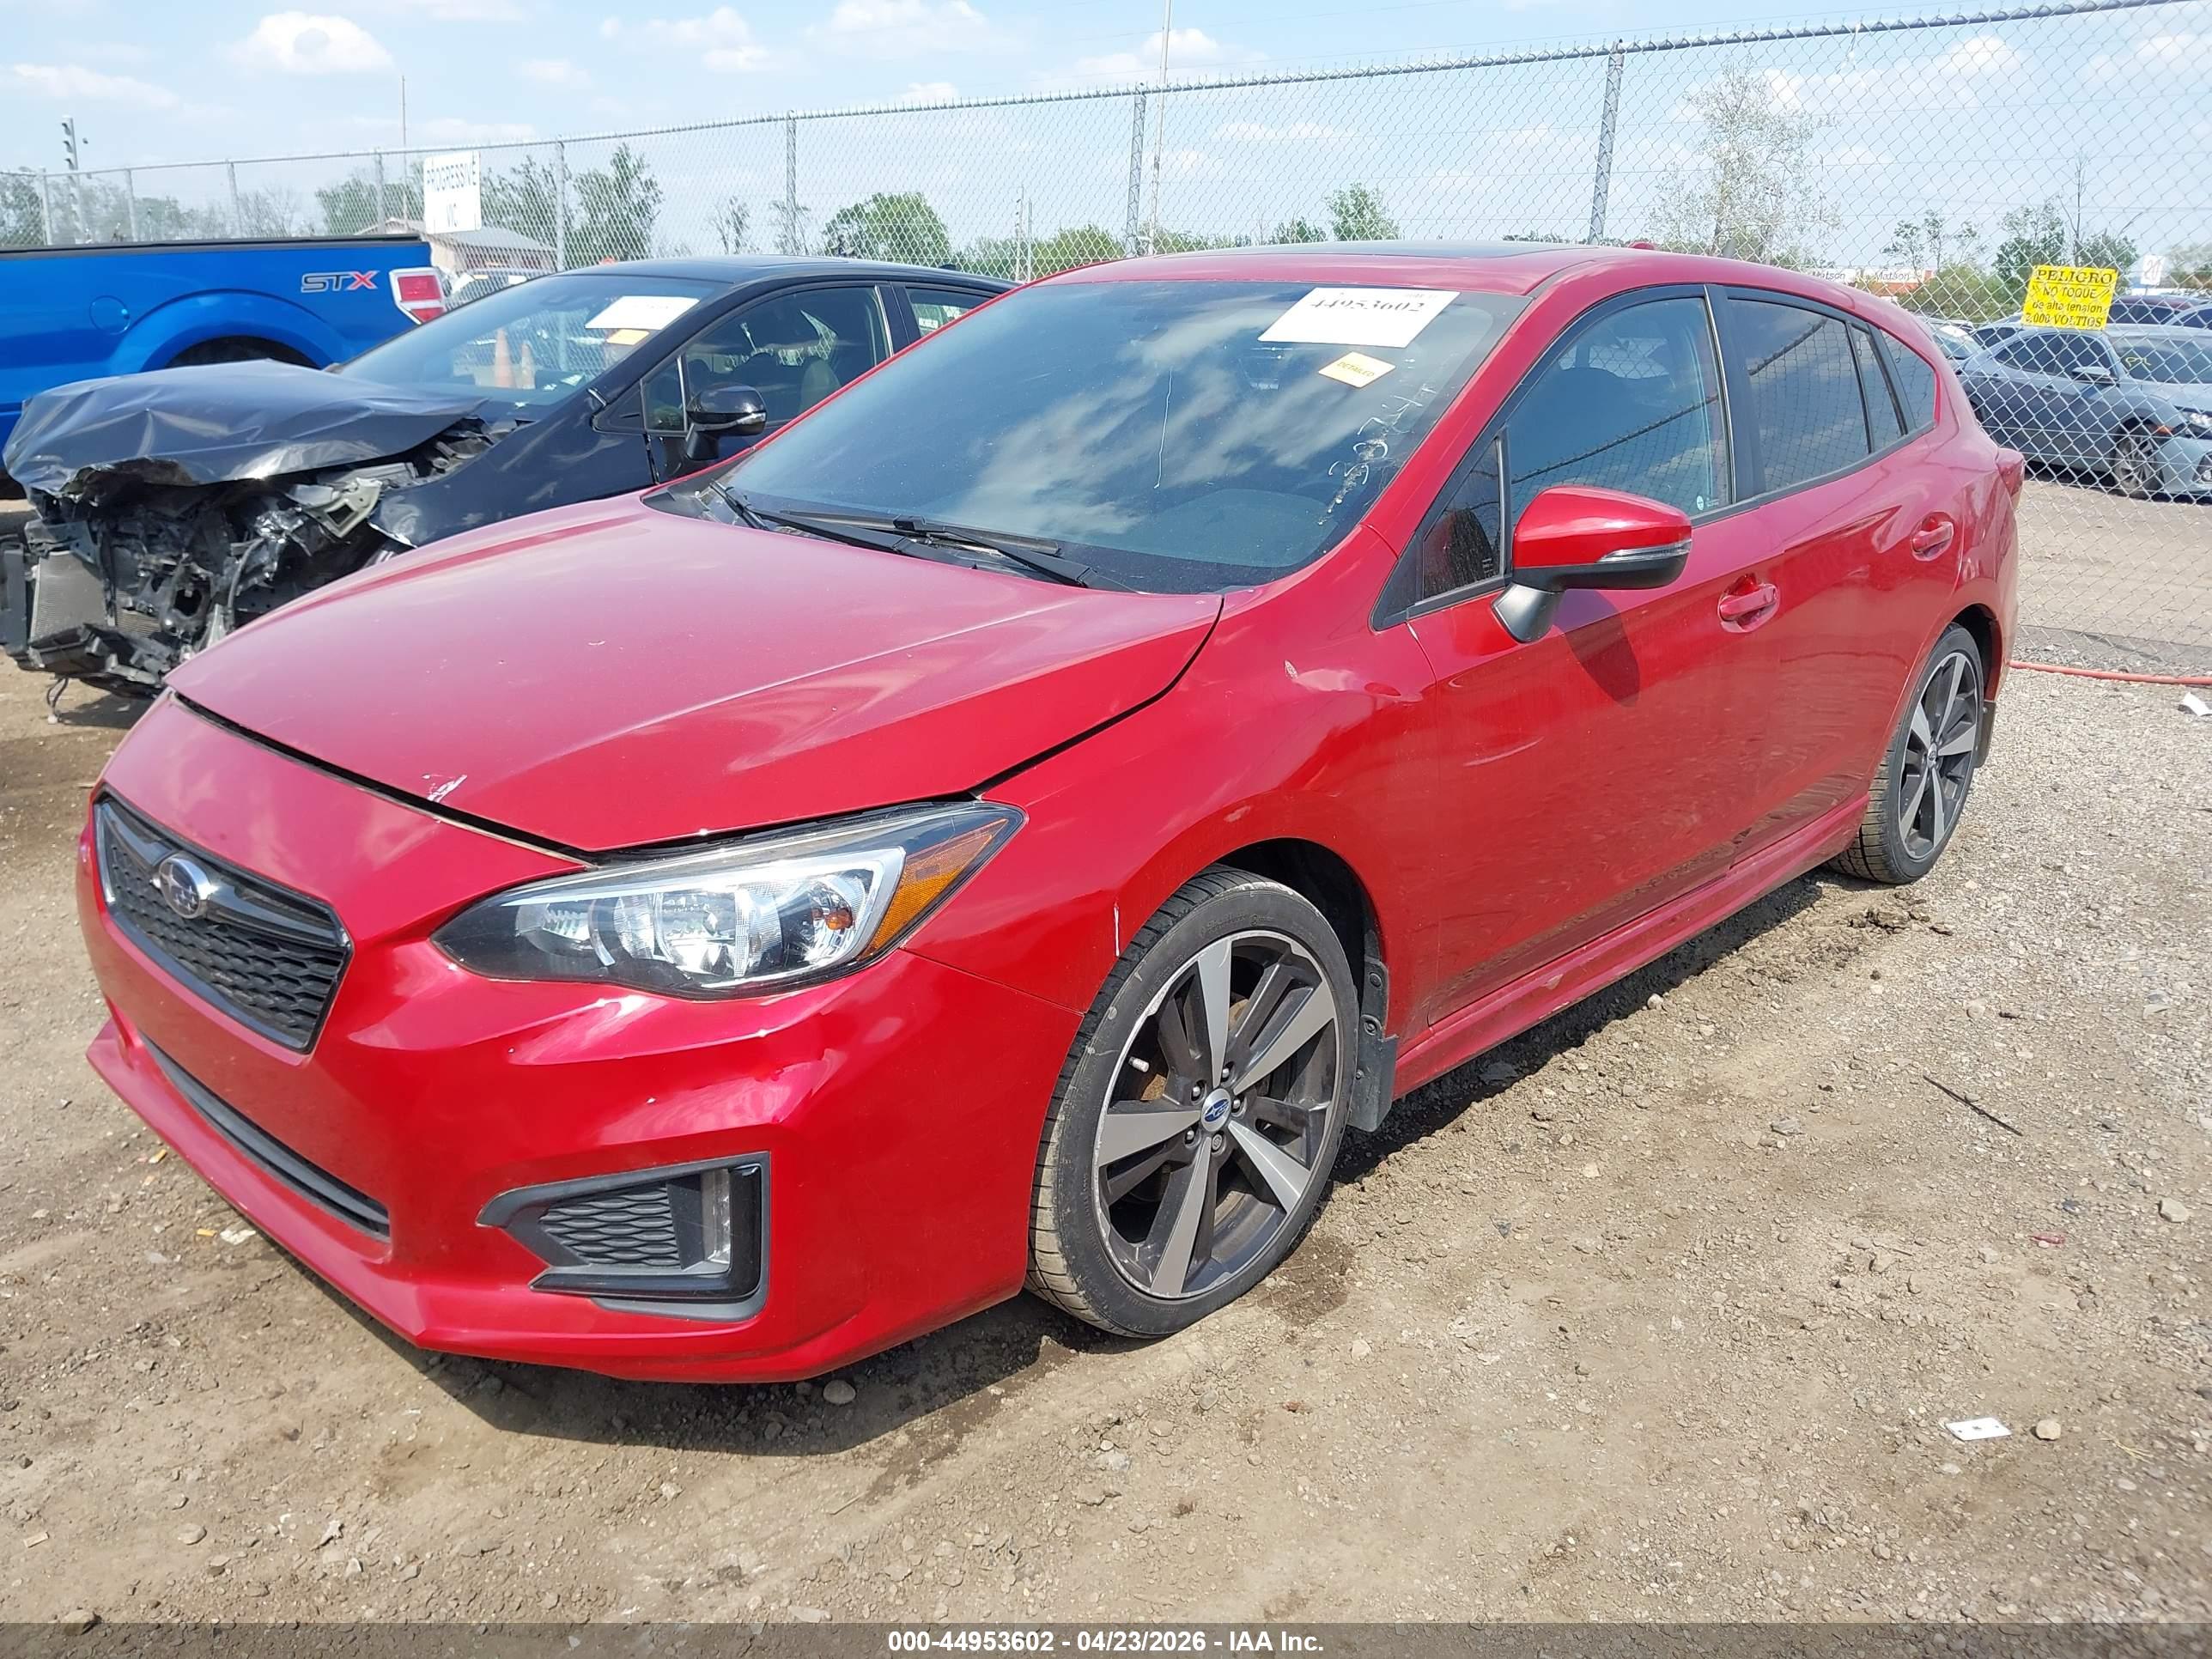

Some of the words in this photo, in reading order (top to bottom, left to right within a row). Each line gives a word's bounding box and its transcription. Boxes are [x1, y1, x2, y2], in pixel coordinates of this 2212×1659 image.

[427, 161, 477, 191] PROGRESSIVE
[301, 270, 380, 293] STX
[2036, 270, 2112, 284] PELIGRO
[2043, 286, 2058, 297] NO
[2062, 286, 2098, 299] TOQUE
[1310, 299, 1425, 312] 44953602
[2032, 300, 2044, 310] de
[2046, 301, 2064, 311] alta
[2054, 314, 2104, 327] VOLTIOS
[1336, 361, 1375, 377] DETAILED
